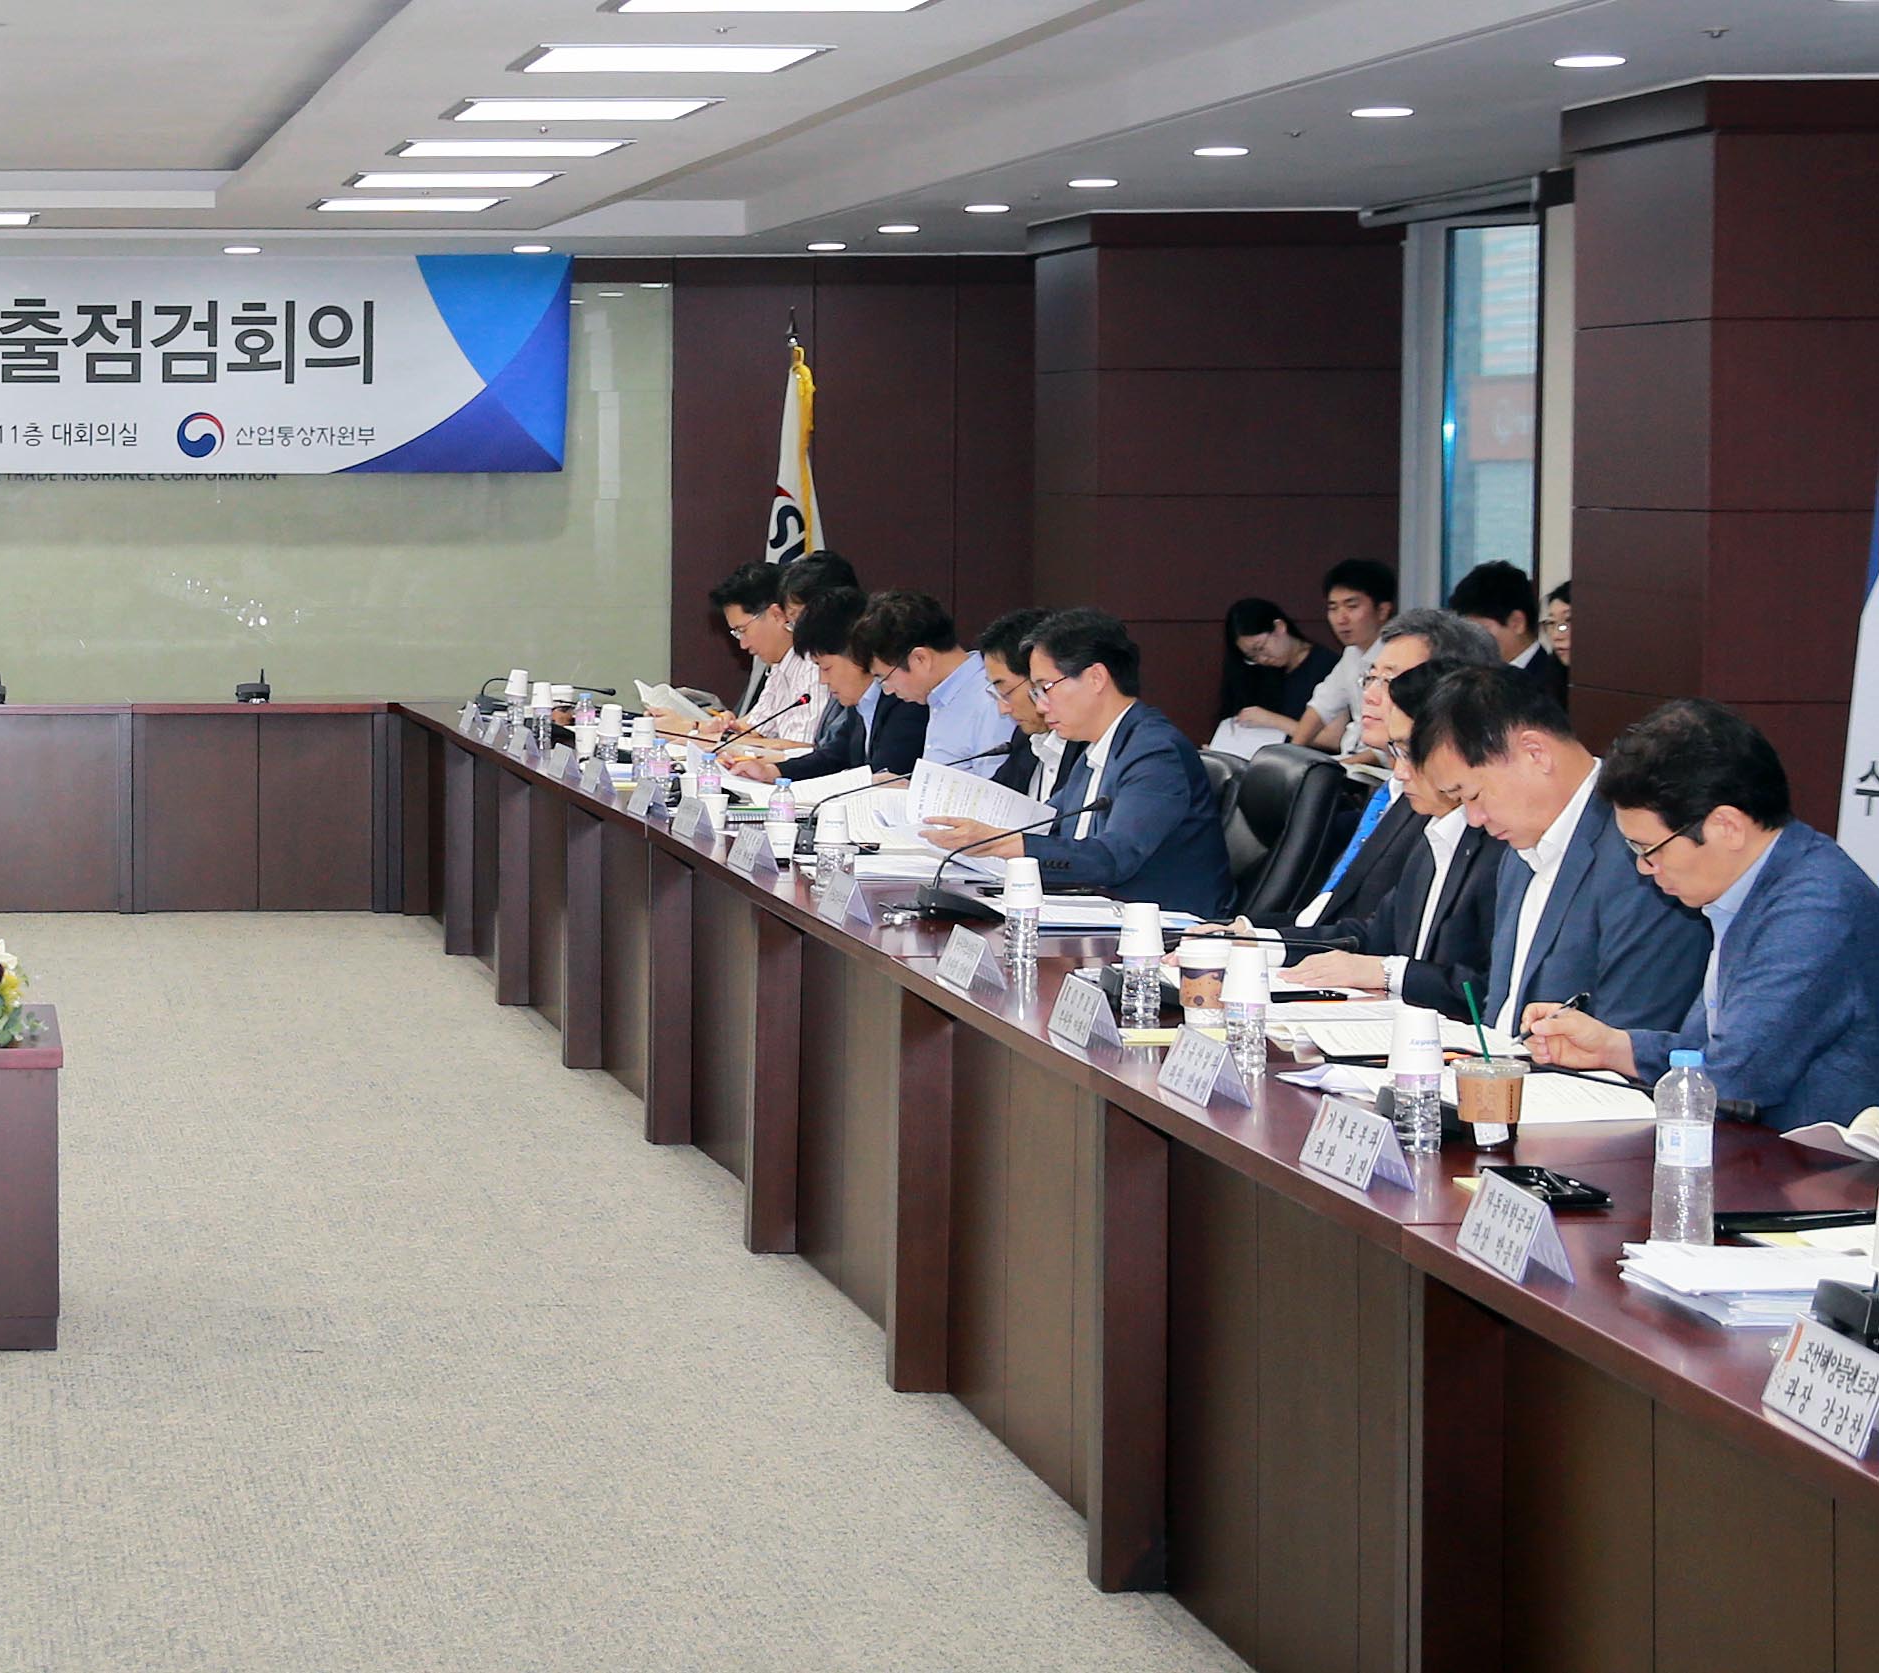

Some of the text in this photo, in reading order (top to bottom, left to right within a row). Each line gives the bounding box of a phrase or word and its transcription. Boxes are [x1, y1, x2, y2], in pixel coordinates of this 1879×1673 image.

[52, 422, 138, 447] 대회의실
[235, 425, 376, 447] 산업통상자원부
[1798, 1341, 1879, 1405] 조선해양플랜트과
[1784, 1376, 1865, 1445] 과장 강감찬
